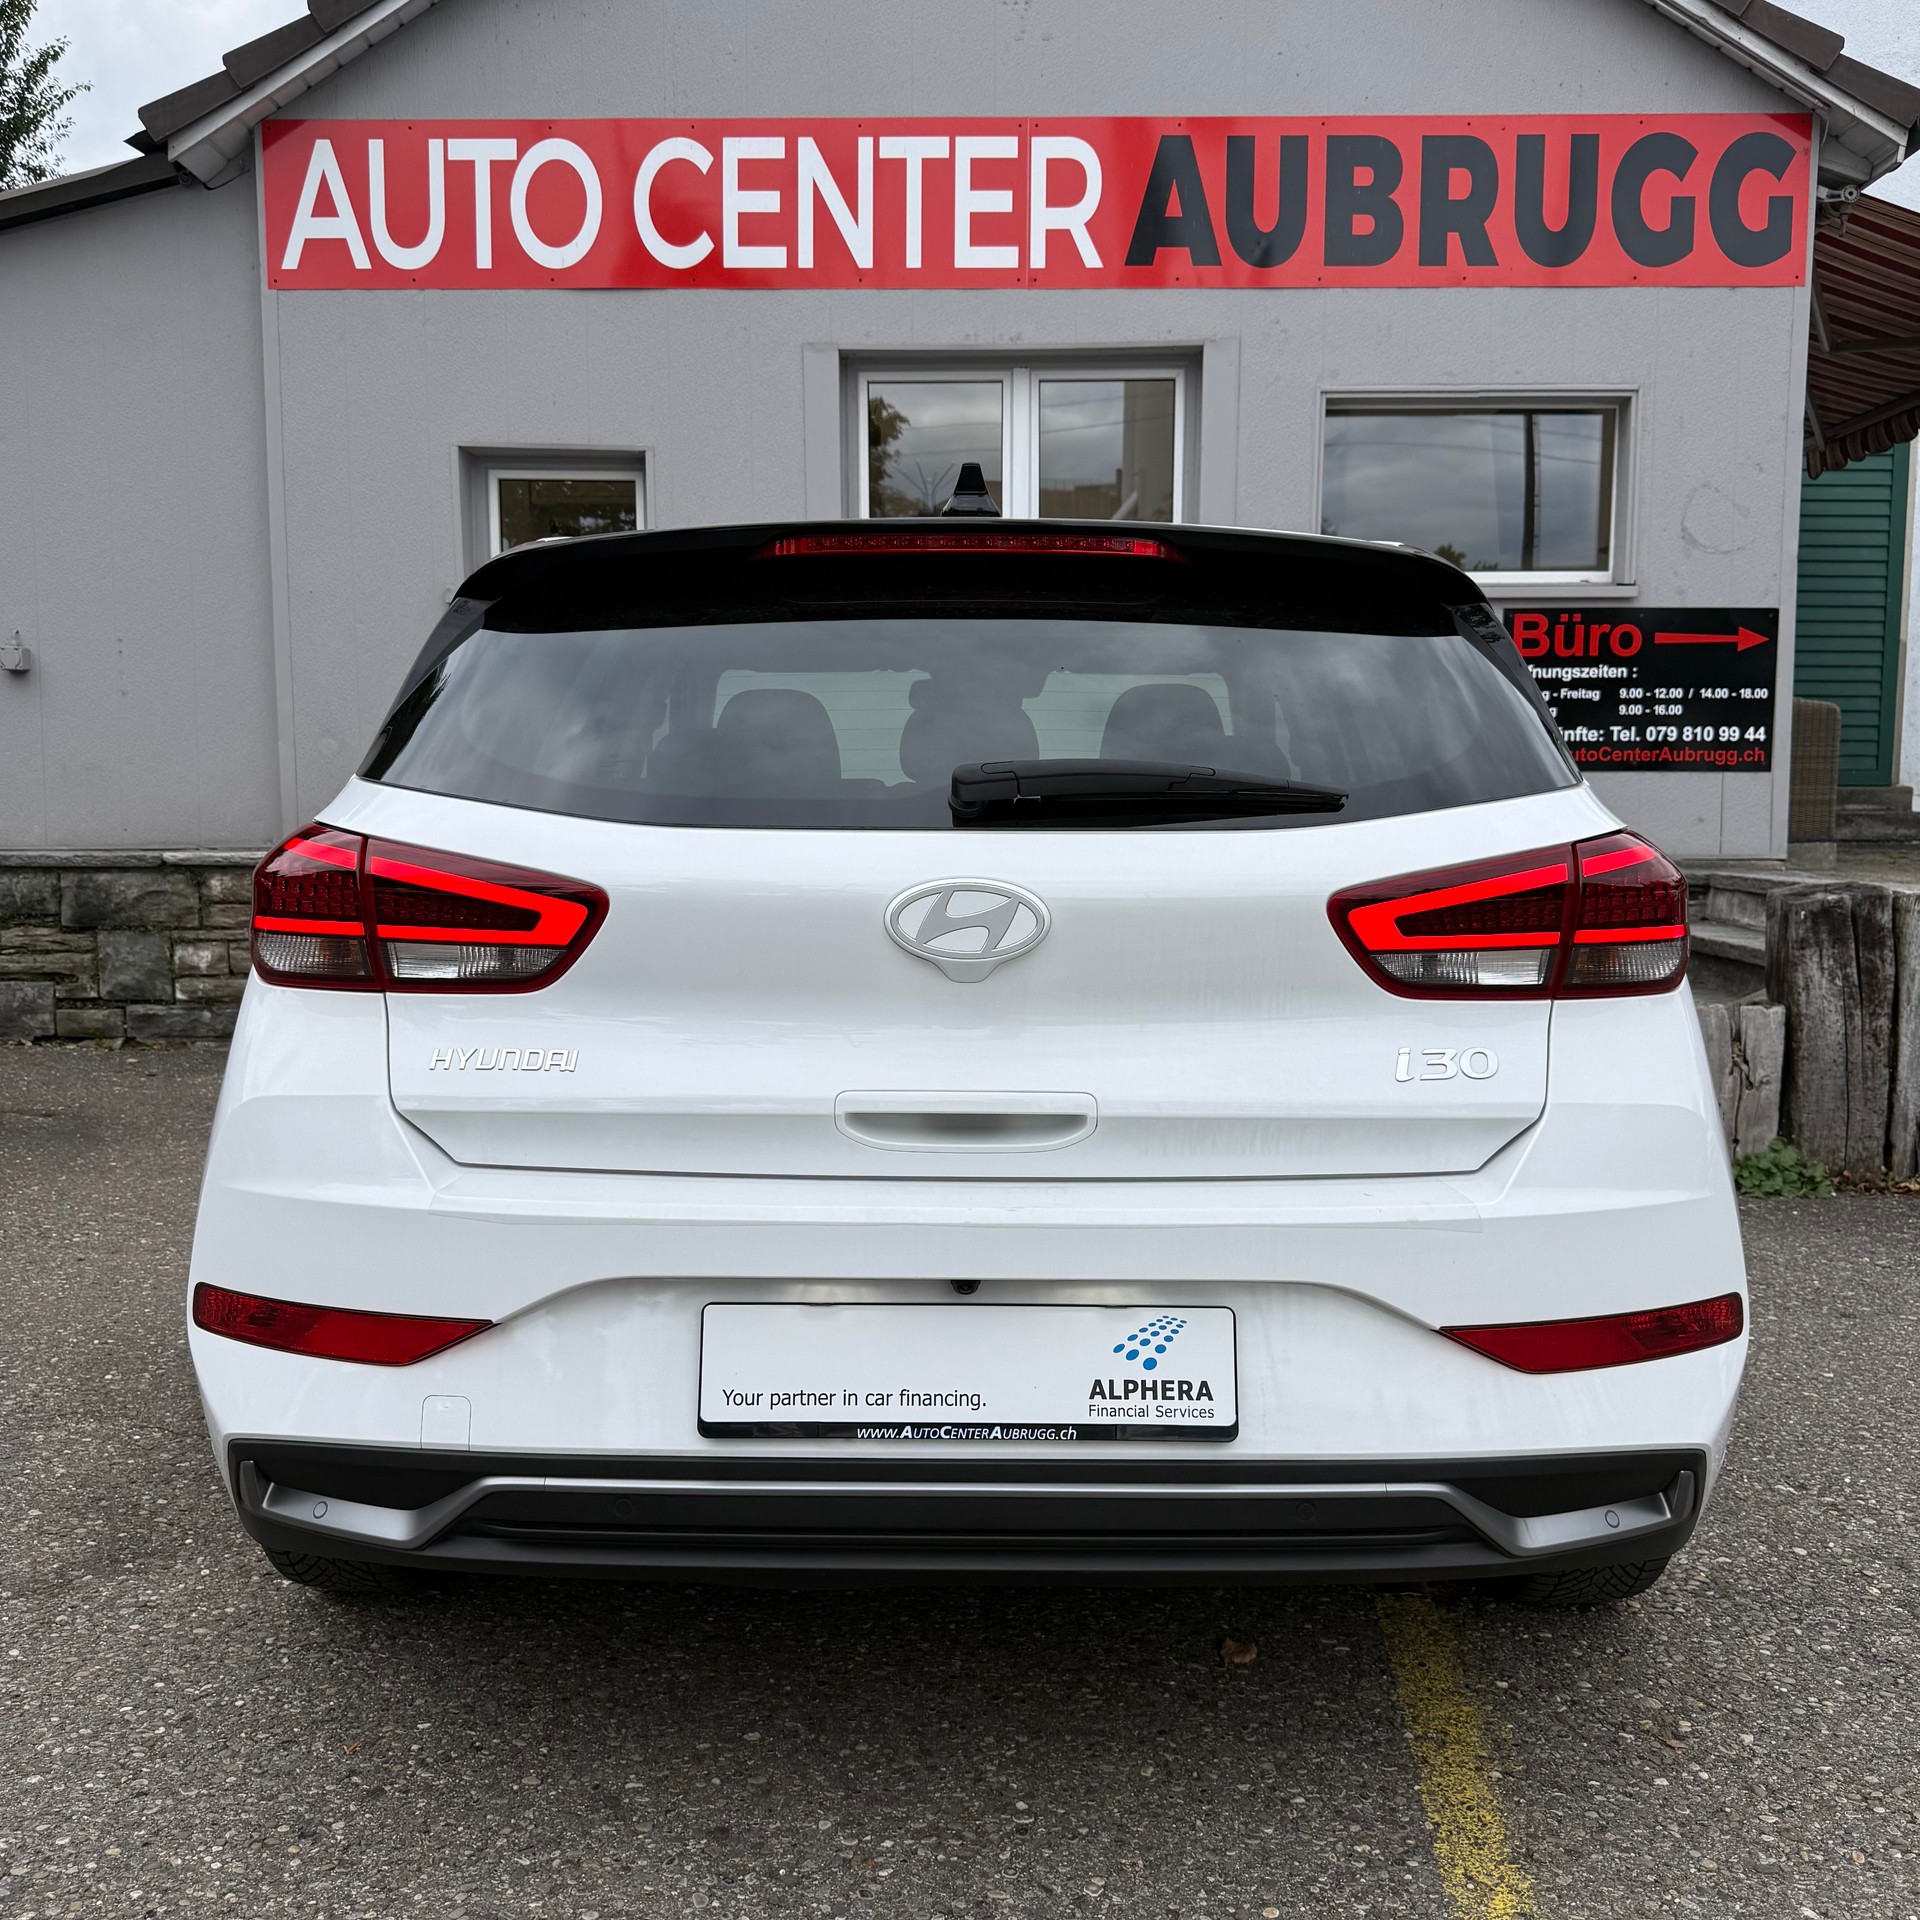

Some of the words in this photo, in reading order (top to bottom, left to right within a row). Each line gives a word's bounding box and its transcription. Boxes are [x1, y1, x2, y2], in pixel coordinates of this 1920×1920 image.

[281, 137, 603, 270] AUTO
[633, 136, 1104, 269] CENTER
[1124, 131, 1798, 268] AUBRUGG
[1512, 613, 1643, 658] Büro
[1560, 687, 1601, 702] Freitag
[1619, 687, 1643, 699] 9.00
[1653, 687, 1683, 699] 12.00
[1688, 687, 1694, 699] /
[1699, 687, 1729, 699] 14.00
[1738, 687, 1769, 699] 18.00
[1618, 704, 1643, 716] 9.00
[1653, 704, 1683, 716] 16.00
[1609, 725, 1641, 742] Tel.
[1645, 725, 1678, 742] 079
[1682, 725, 1713, 742] 810
[1718, 725, 1742, 742] 99
[1743, 725, 1766, 742] 44
[429, 1048, 579, 1072] HYUNDAI
[1395, 1047, 1499, 1082] i30
[722, 1388, 764, 1407] Your
[770, 1389, 837, 1411] partner
[843, 1388, 858, 1407] in
[865, 1391, 894, 1407] car
[898, 1388, 987, 1411] financing.
[1088, 1379, 1214, 1401] ALPHERA
[1088, 1404, 1149, 1418] Financial
[1155, 1404, 1215, 1419] Services
